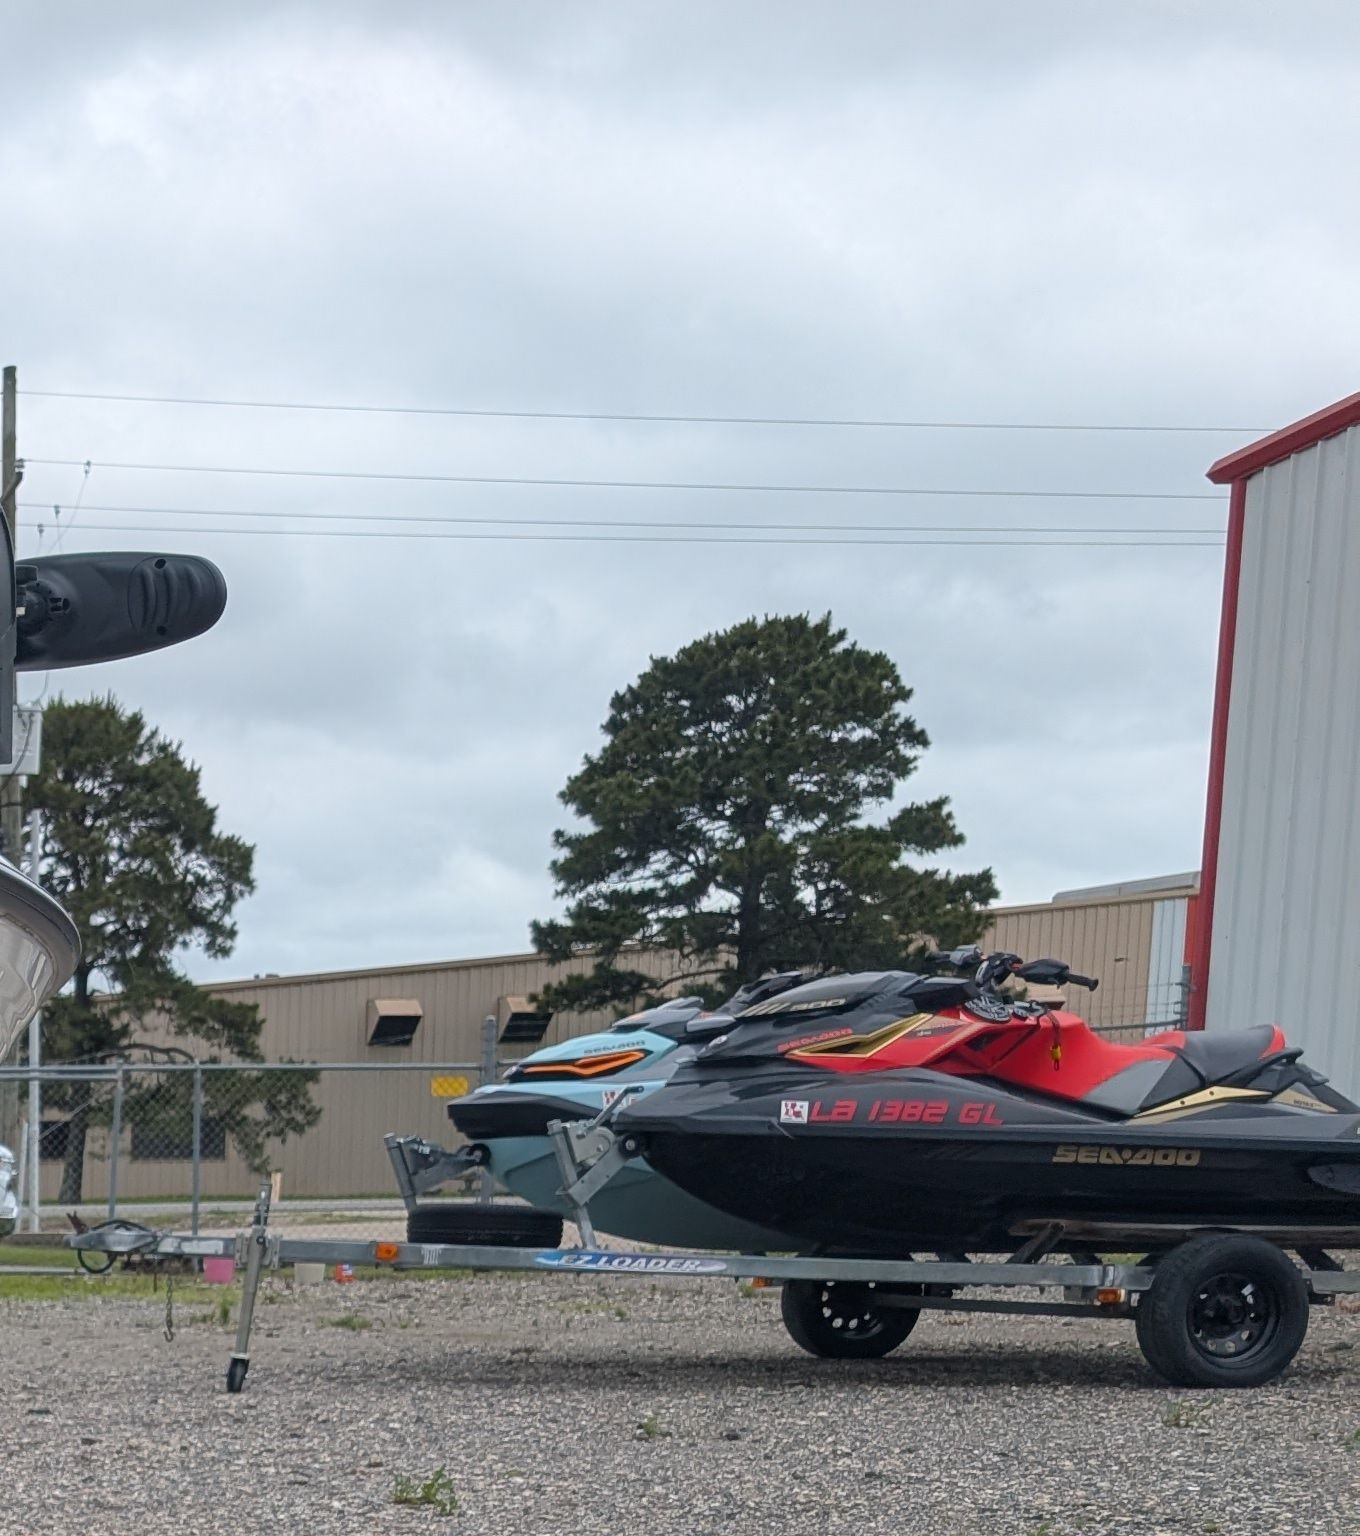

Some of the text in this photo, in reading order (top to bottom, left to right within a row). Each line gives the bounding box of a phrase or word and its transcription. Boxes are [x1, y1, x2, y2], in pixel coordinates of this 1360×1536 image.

[809, 1100, 1004, 1125] LA 1382 GL
[559, 1254, 702, 1272] EZ LOADER
